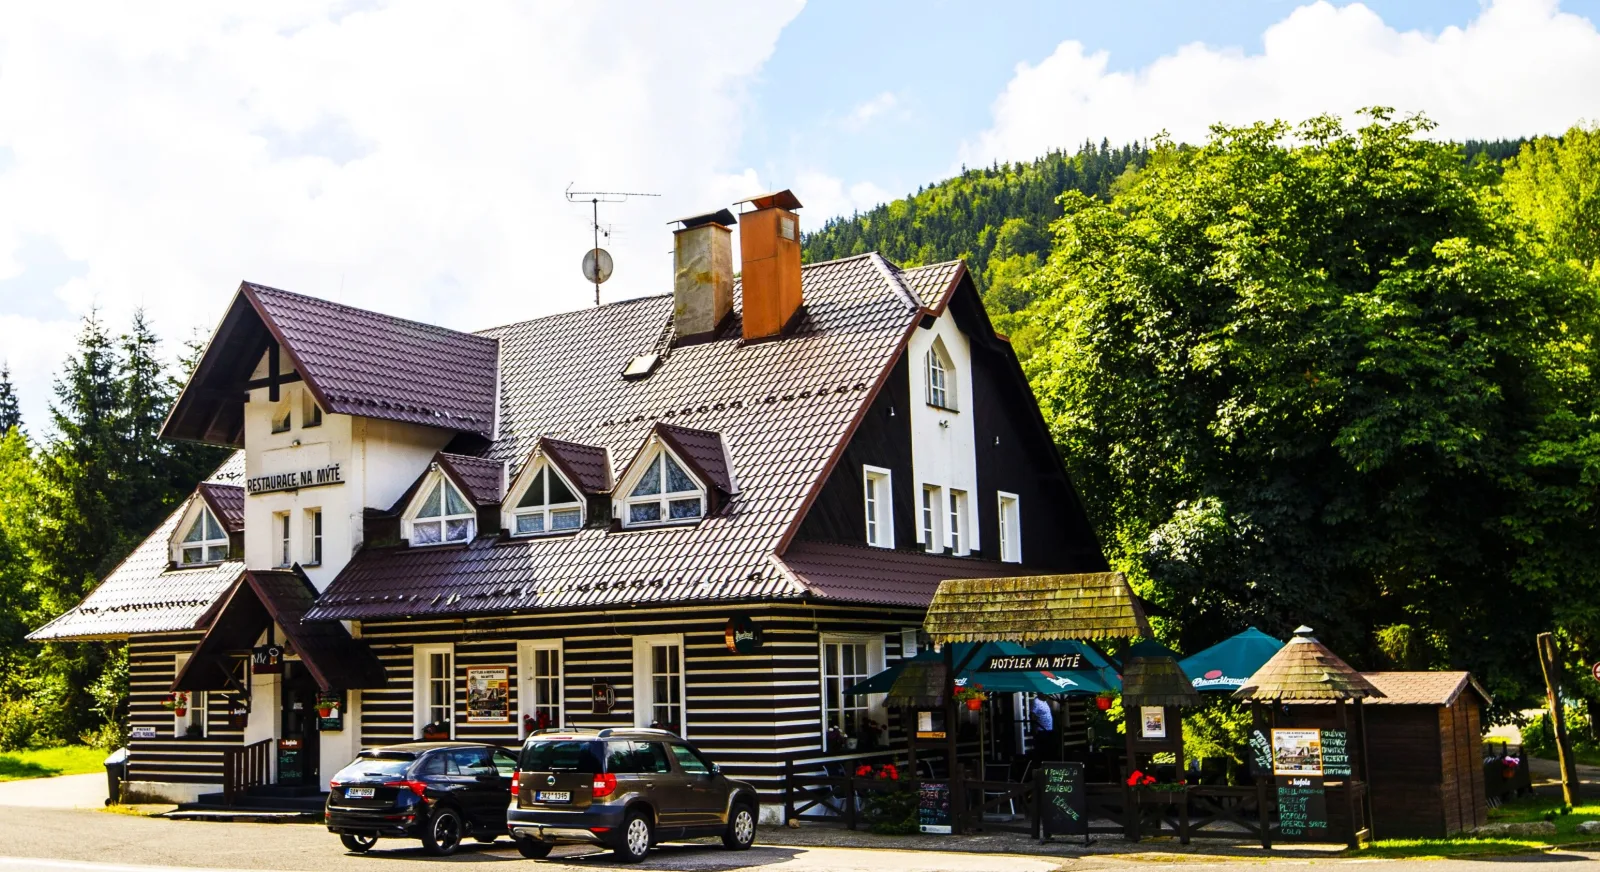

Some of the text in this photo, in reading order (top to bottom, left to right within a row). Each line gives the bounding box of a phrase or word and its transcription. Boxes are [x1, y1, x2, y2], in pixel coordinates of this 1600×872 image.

[247, 463, 341, 492] RESTAURACE NA MÝTĚ
[990, 653, 1081, 669] HOTÝLEK NA MÝTĚ
